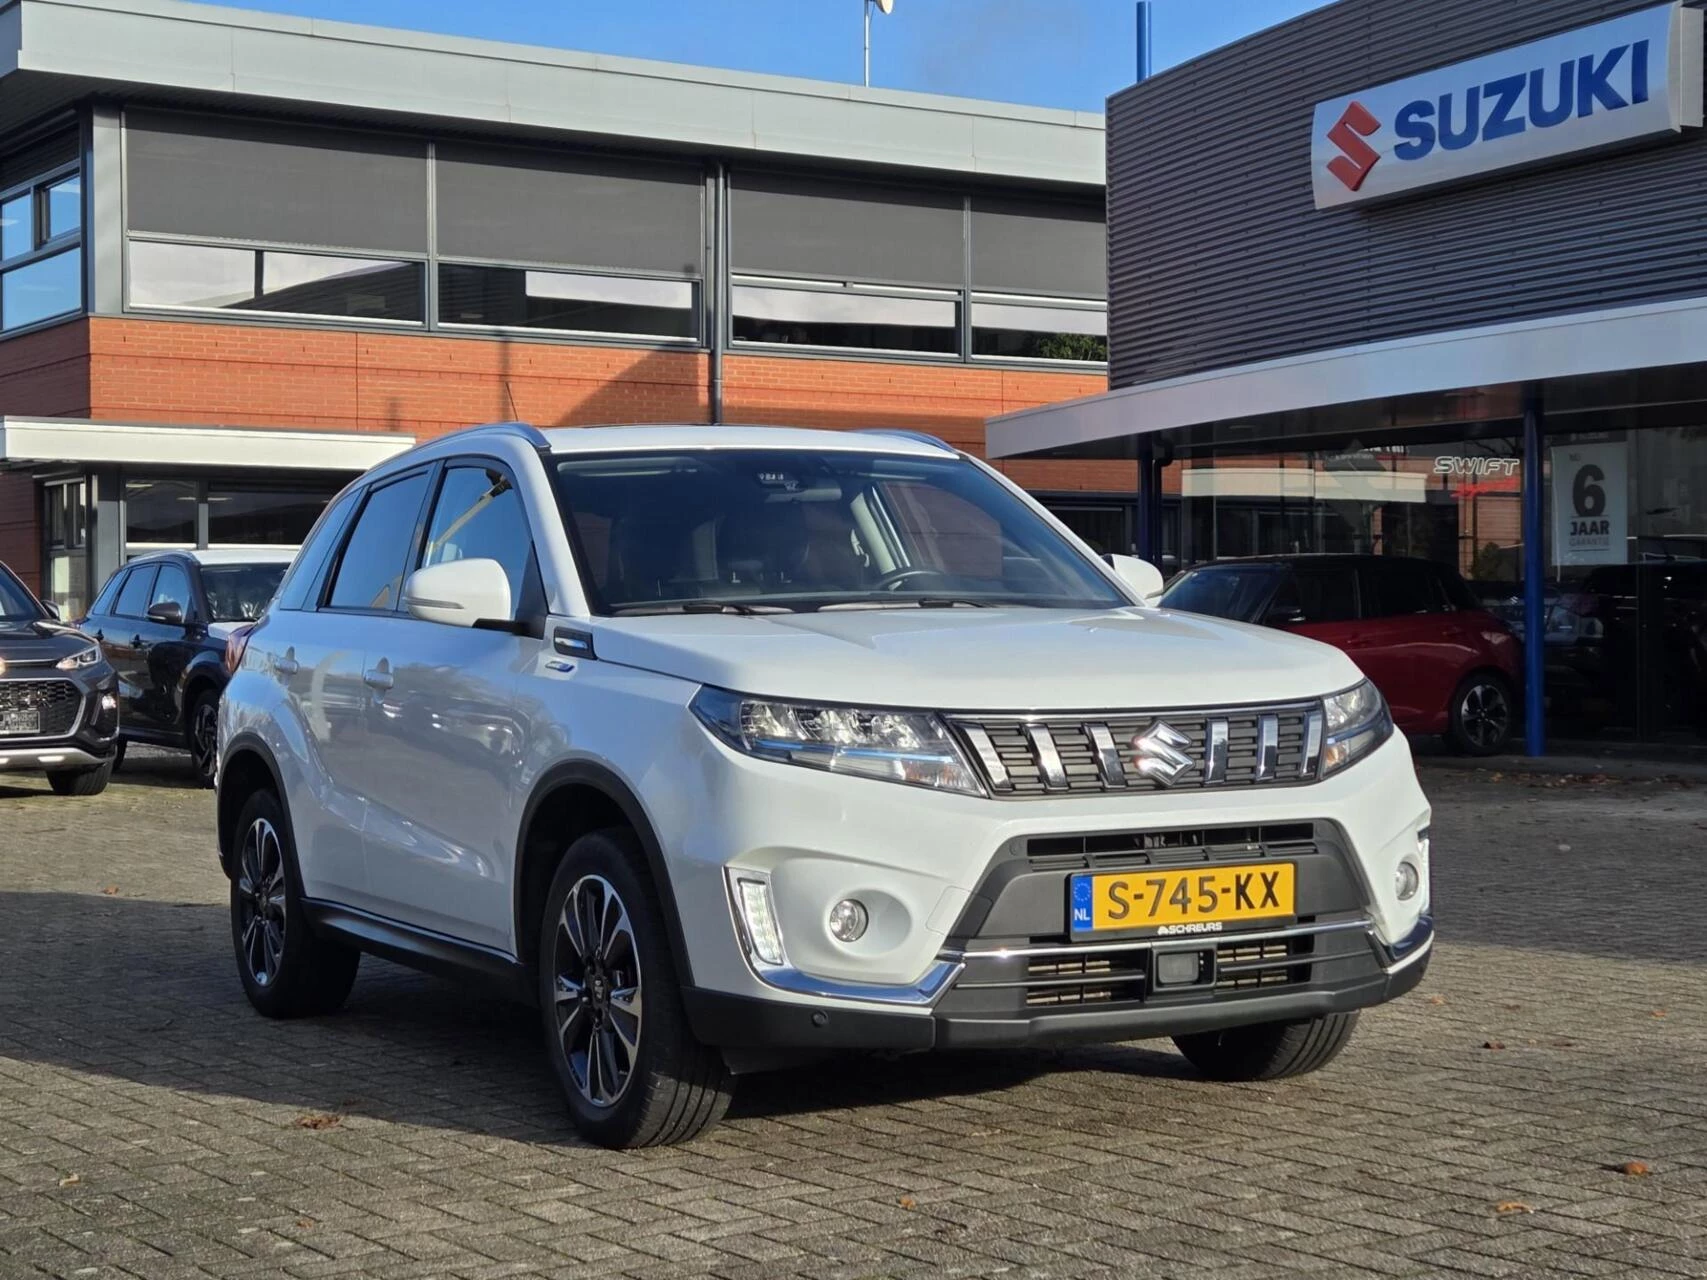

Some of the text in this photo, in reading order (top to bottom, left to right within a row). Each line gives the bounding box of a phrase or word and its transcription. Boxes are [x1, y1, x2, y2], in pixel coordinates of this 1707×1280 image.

[1393, 38, 1650, 161] SUZUKI
[1433, 455, 1520, 476] SWIFT
[1573, 463, 1606, 517] 6
[1570, 520, 1610, 536] JAAR
[1108, 871, 1280, 920] S-745-KX
[1074, 908, 1091, 922] NL
[1168, 922, 1223, 935] SCHREURS
